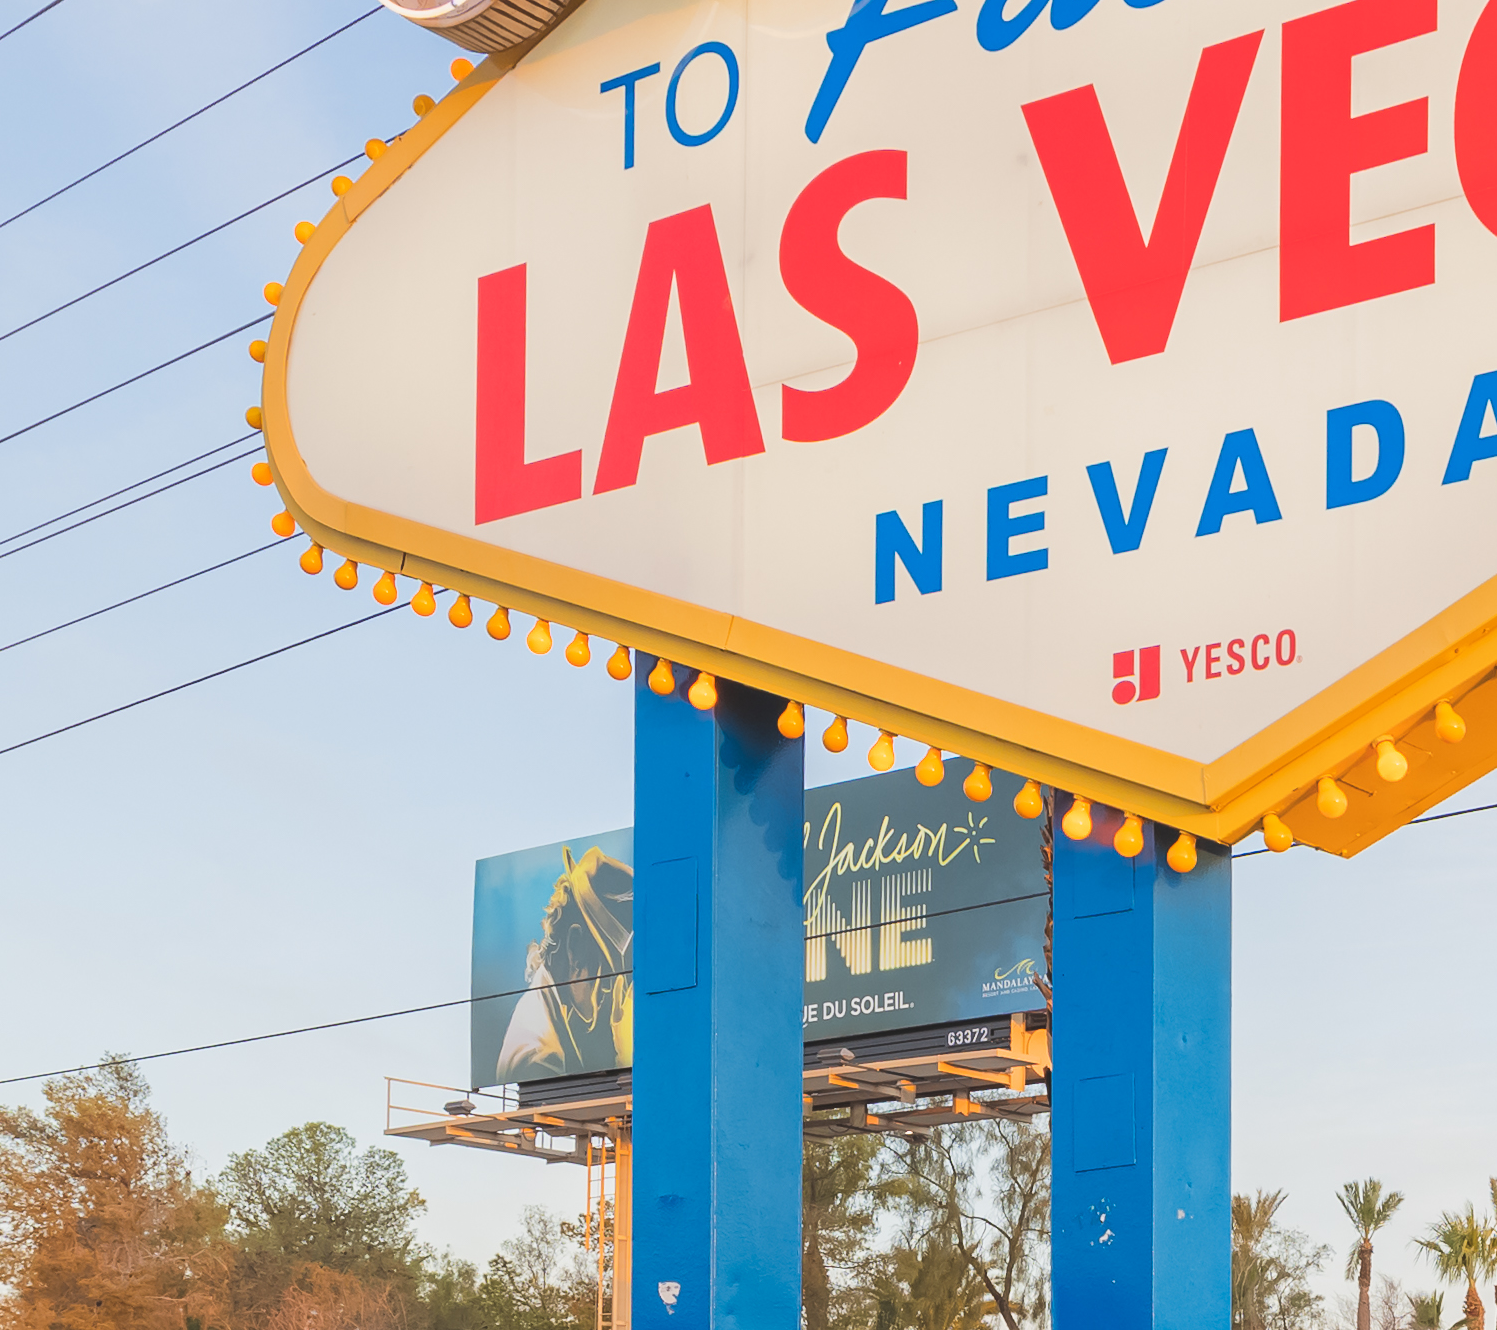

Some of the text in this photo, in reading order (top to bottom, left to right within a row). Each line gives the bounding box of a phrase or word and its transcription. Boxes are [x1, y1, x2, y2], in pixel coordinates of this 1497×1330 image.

[599, 40, 740, 170] TO
[474, 148, 920, 527] LAS
[1179, 628, 1298, 684] YESCO
[803, 801, 971, 927] Jackson
[805, 867, 933, 983] NE
[822, 999, 847, 1021] DU
[947, 1027, 989, 1046] 63372
